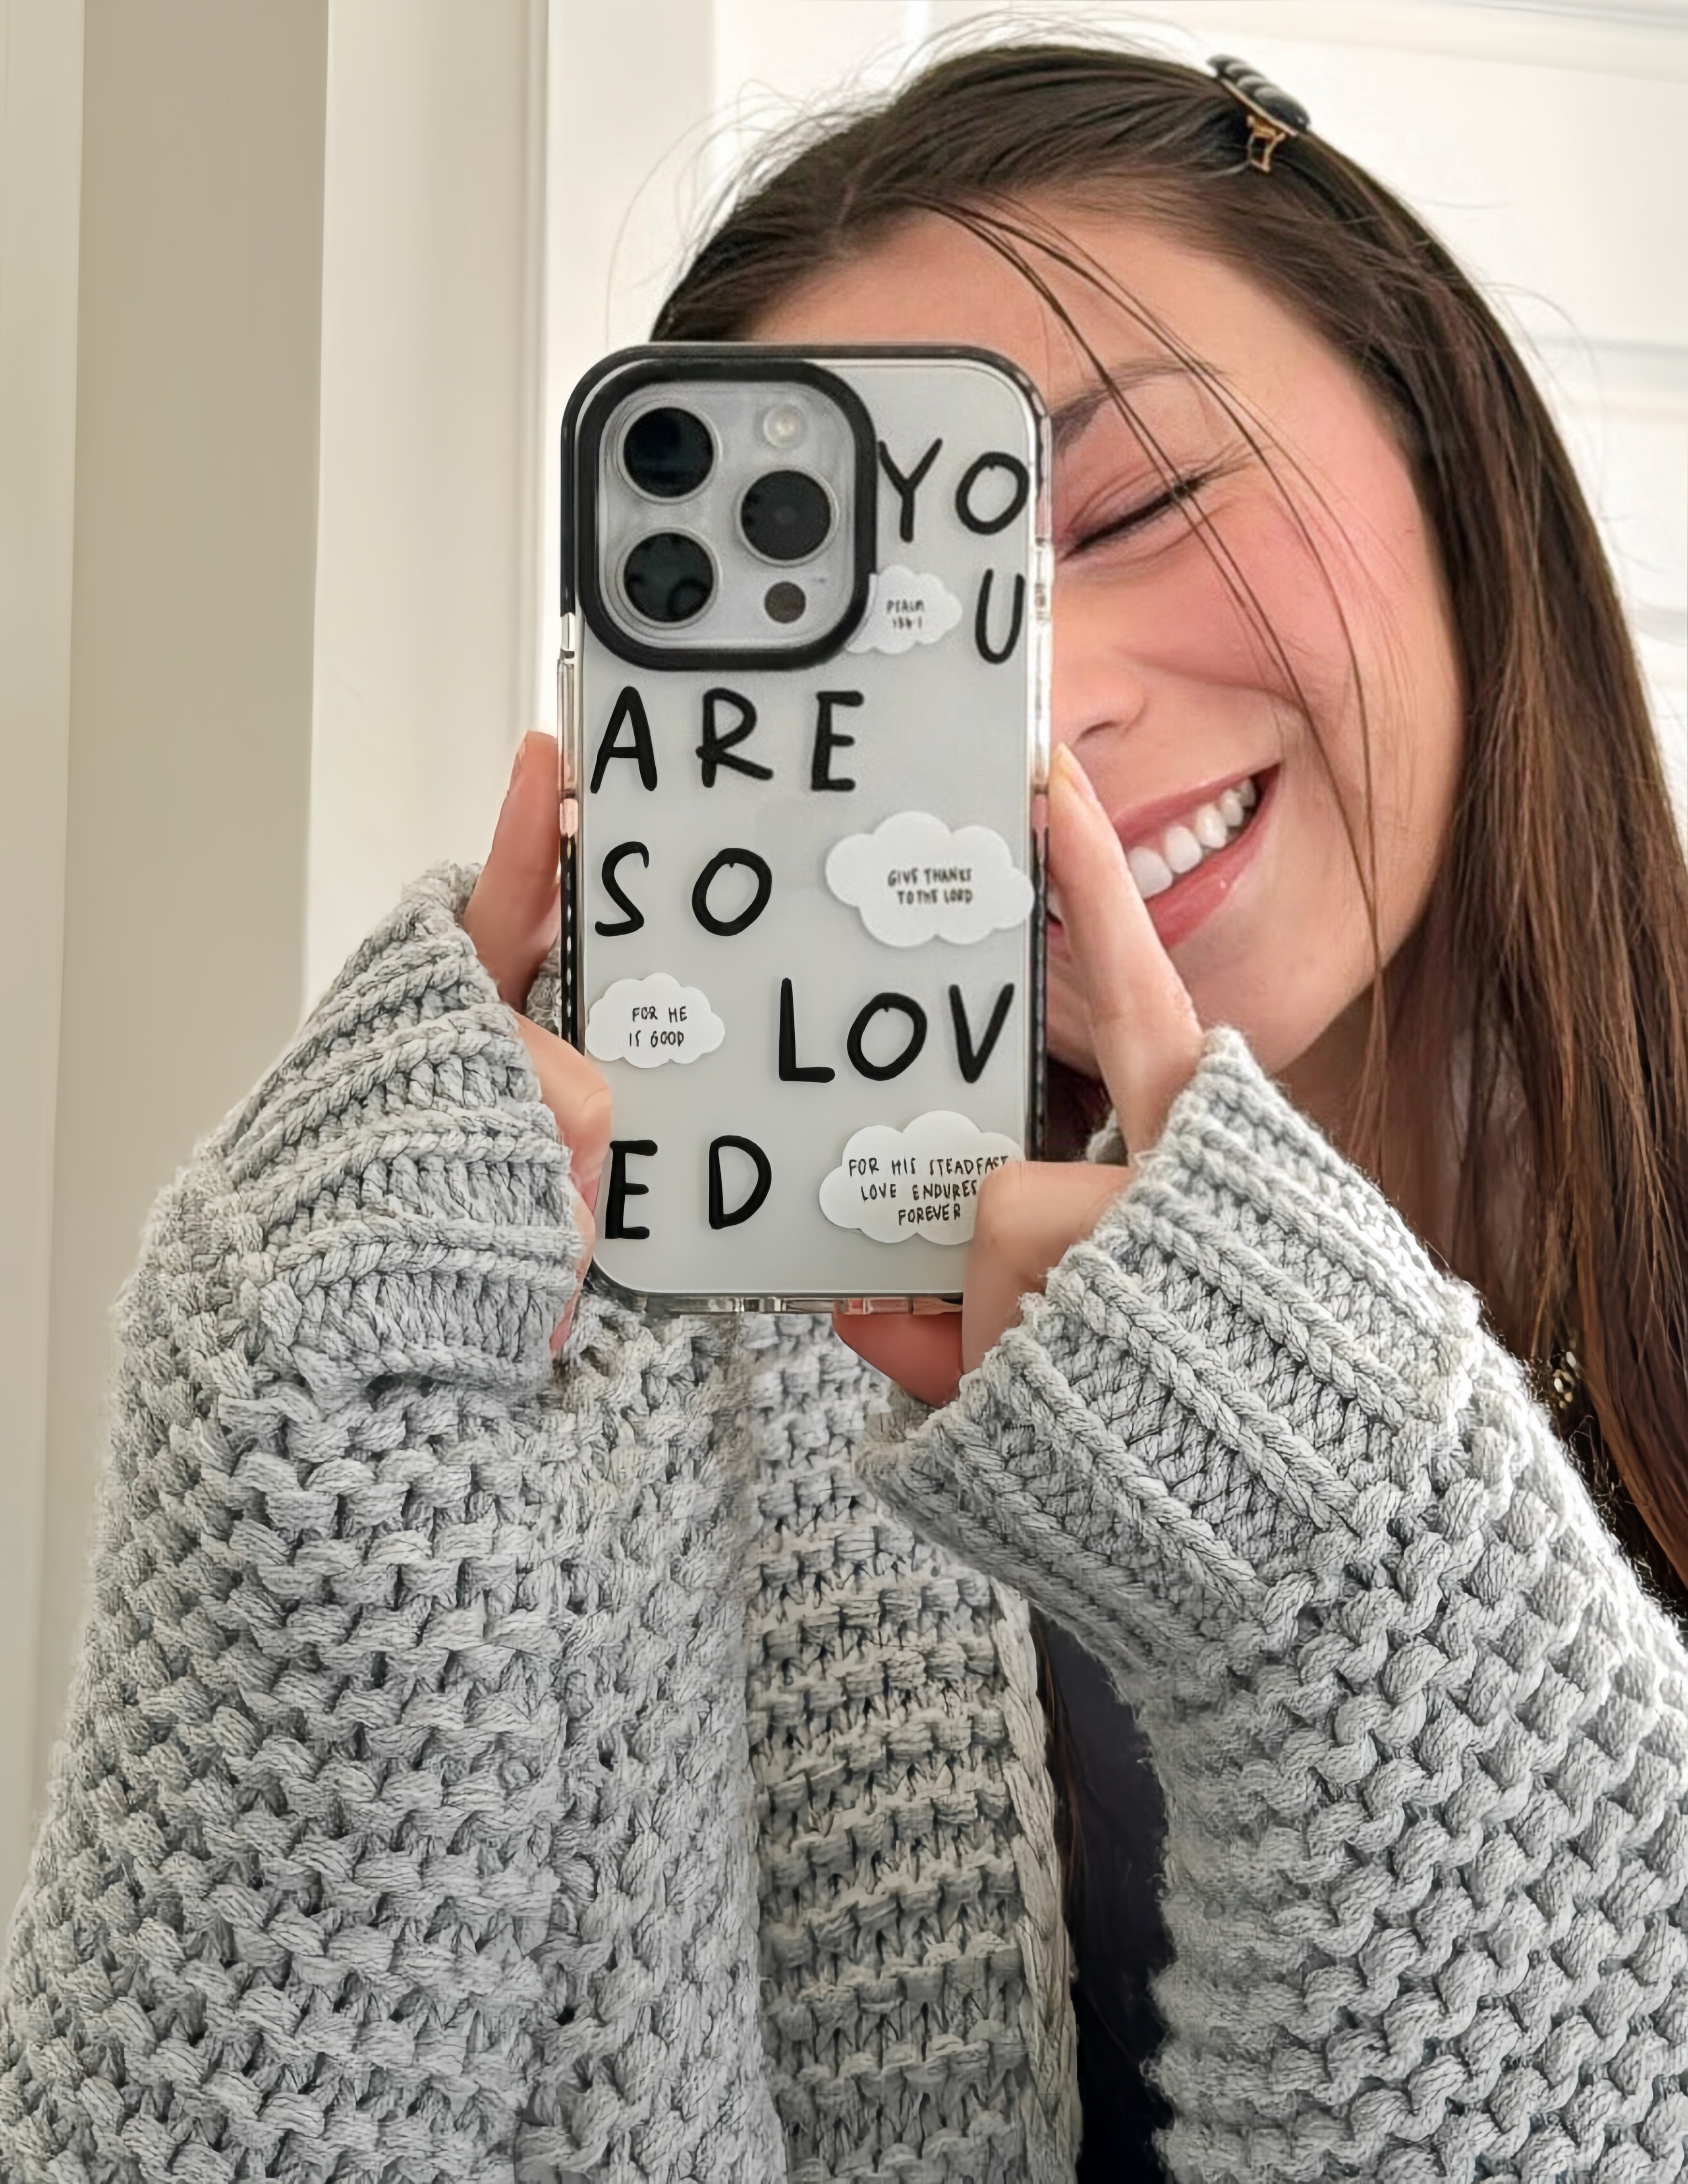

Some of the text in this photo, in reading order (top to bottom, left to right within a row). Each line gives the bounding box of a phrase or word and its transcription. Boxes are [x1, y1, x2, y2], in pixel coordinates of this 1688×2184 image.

[877, 437, 1030, 543] YO
[975, 568, 1027, 664] U
[590, 686, 864, 794] ARE
[887, 867, 972, 886] GIVE THANKS
[594, 840, 773, 937] SO
[897, 888, 973, 905] TO THE LORD
[632, 1006, 688, 1023] FOR HE
[629, 1030, 684, 1048] IS GOOD
[778, 977, 1015, 1083] LOV
[848, 1158, 879, 1176] FOR
[891, 1158, 916, 1175] HIS
[605, 1134, 772, 1240] ED
[861, 1180, 977, 1202] LOVE ENDURES
[898, 1203, 961, 1225] FOREVER
